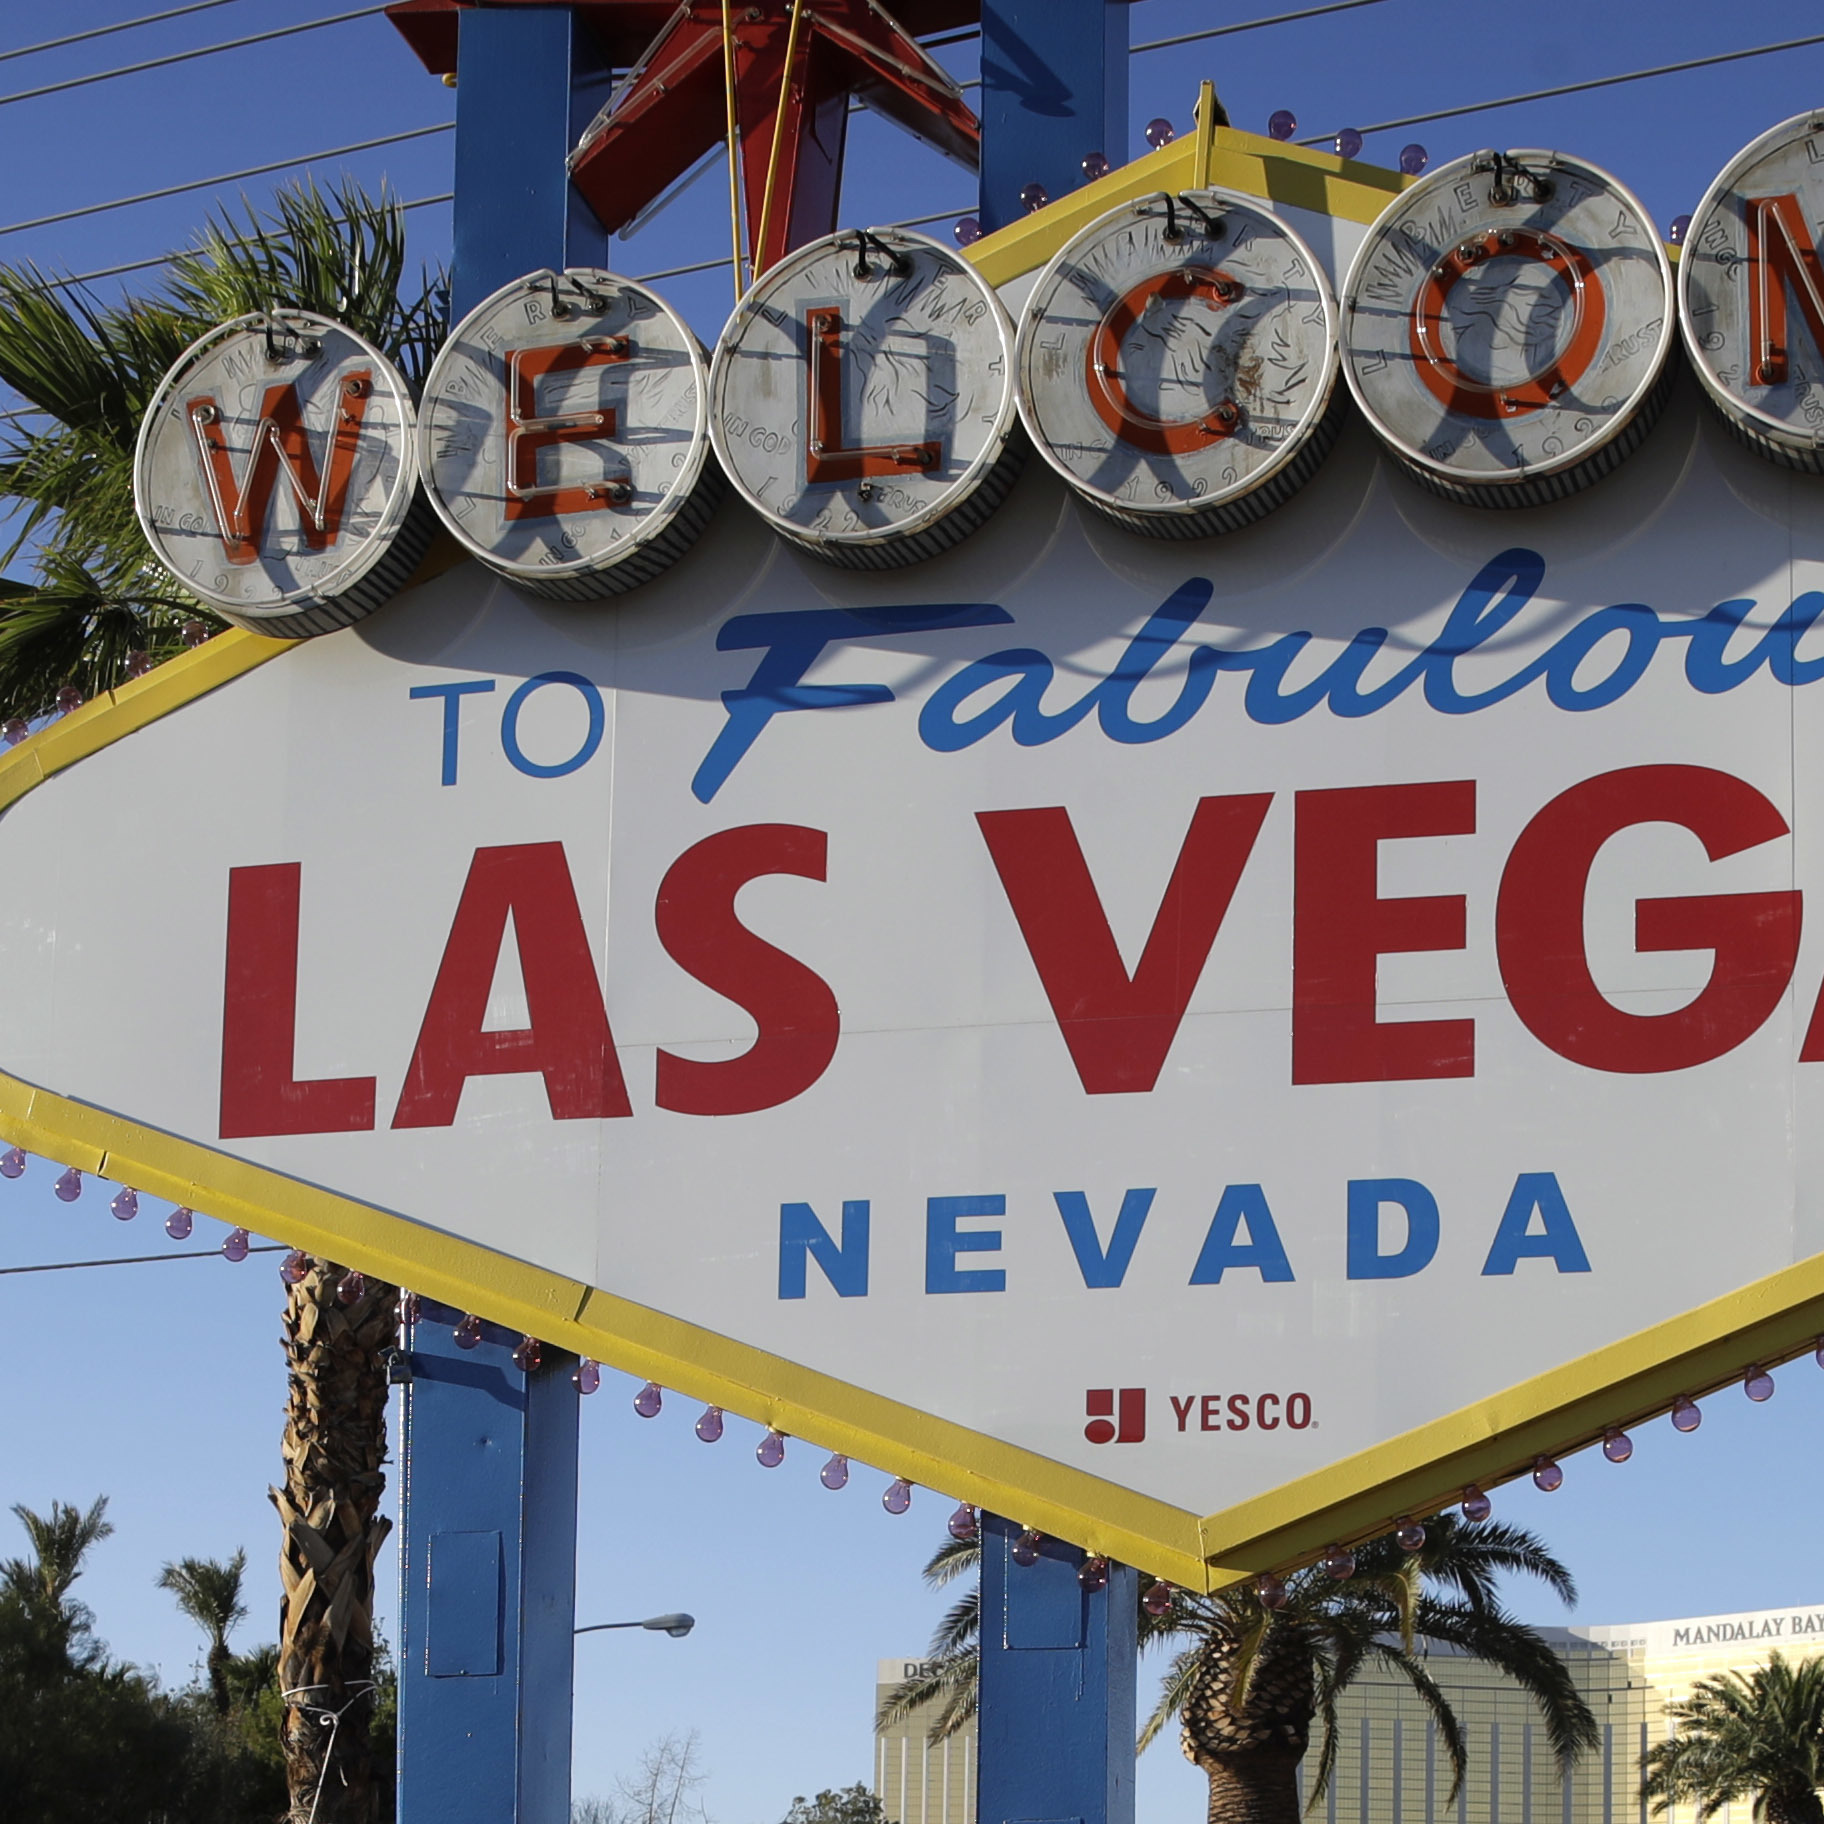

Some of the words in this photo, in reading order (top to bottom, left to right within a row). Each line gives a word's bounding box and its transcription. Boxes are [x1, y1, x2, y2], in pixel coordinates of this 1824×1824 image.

[409, 671, 607, 788] TO
[219, 823, 842, 1140] LAS
[776, 1172, 1594, 1302] NEVADA
[1169, 1394, 1316, 1434] YESCO
[1672, 1617, 1785, 1648] MANDALAY
